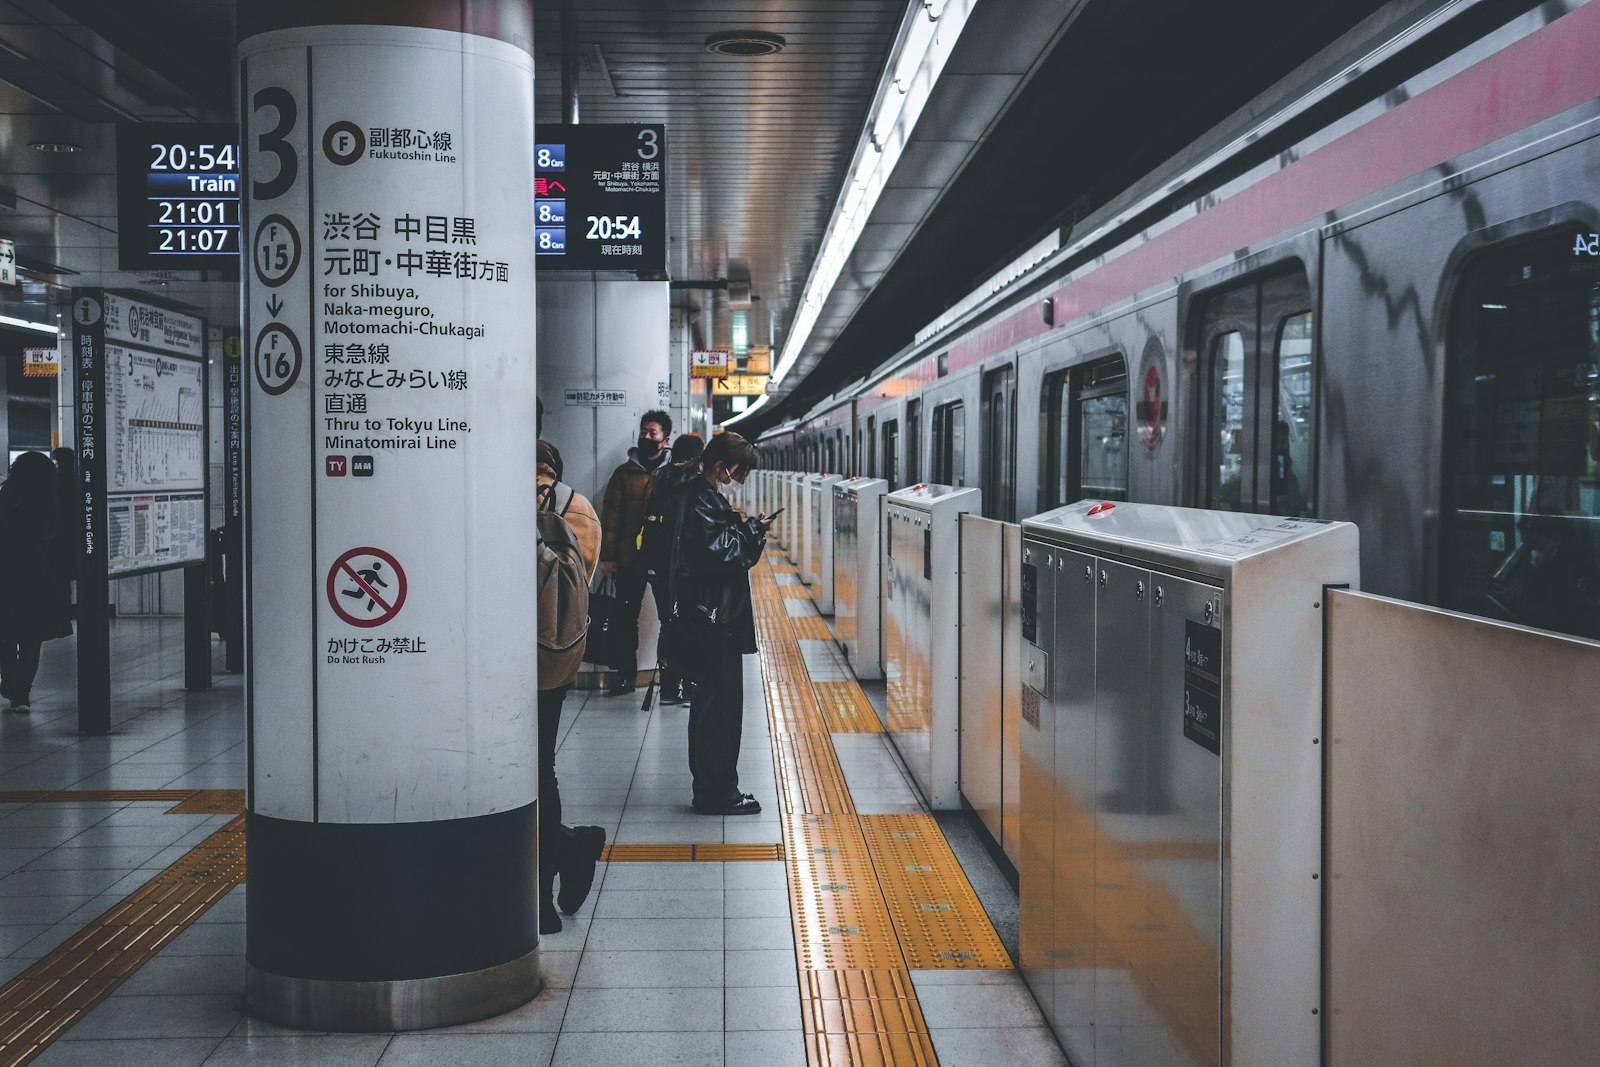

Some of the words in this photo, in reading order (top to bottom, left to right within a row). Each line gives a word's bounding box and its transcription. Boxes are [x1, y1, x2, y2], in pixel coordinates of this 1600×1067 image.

[253, 87, 298, 200] 3
[339, 137, 348, 151] F
[370, 128, 451, 152] 副都心線
[638, 129, 658, 159] 3
[151, 145, 235, 170] 20:54
[370, 149, 430, 160] Fukutoshin
[436, 153, 455, 163] Line
[537, 149, 550, 167] 8
[550, 159, 564, 167] Cars
[622, 162, 639, 171] 渋谷
[642, 170, 659, 180] 方面
[187, 176, 236, 192] Train
[159, 202, 224, 223] 21:01
[539, 205, 550, 222] 8
[551, 214, 564, 222] Cars
[271, 226, 277, 241] F
[324, 213, 380, 240] 渋谷
[395, 214, 475, 245] 中目黒
[586, 216, 641, 239] 20:54
[160, 230, 227, 250] 21:07
[539, 232, 550, 249] 8
[551, 241, 564, 249] Cars
[262, 244, 289, 271] 15
[602, 245, 642, 255] 現在時刻
[324, 248, 508, 283] 元町・中華街方面
[324, 284, 345, 297] for
[351, 284, 419, 300] Shibuya,
[324, 302, 435, 320] Naka-meguro,
[324, 321, 484, 339] Motomachi-Chukagai
[272, 335, 277, 349] F
[325, 343, 389, 364] 東急線
[263, 353, 291, 379] 16
[325, 369, 467, 390] みなとみらい線
[81, 335, 94, 460] 時刻表・停車駅のご案内
[325, 393, 367, 414] 直通
[576, 391, 625, 401] 防犯カメラ作動中
[325, 417, 359, 430] Thru
[365, 419, 381, 430] to
[386, 418, 433, 434] Tokyu
[437, 418, 472, 433] Line,
[326, 436, 420, 448] Minatomirai
[427, 436, 456, 448] Line
[328, 461, 344, 471] TY
[328, 637, 426, 653] かけこみ禁止
